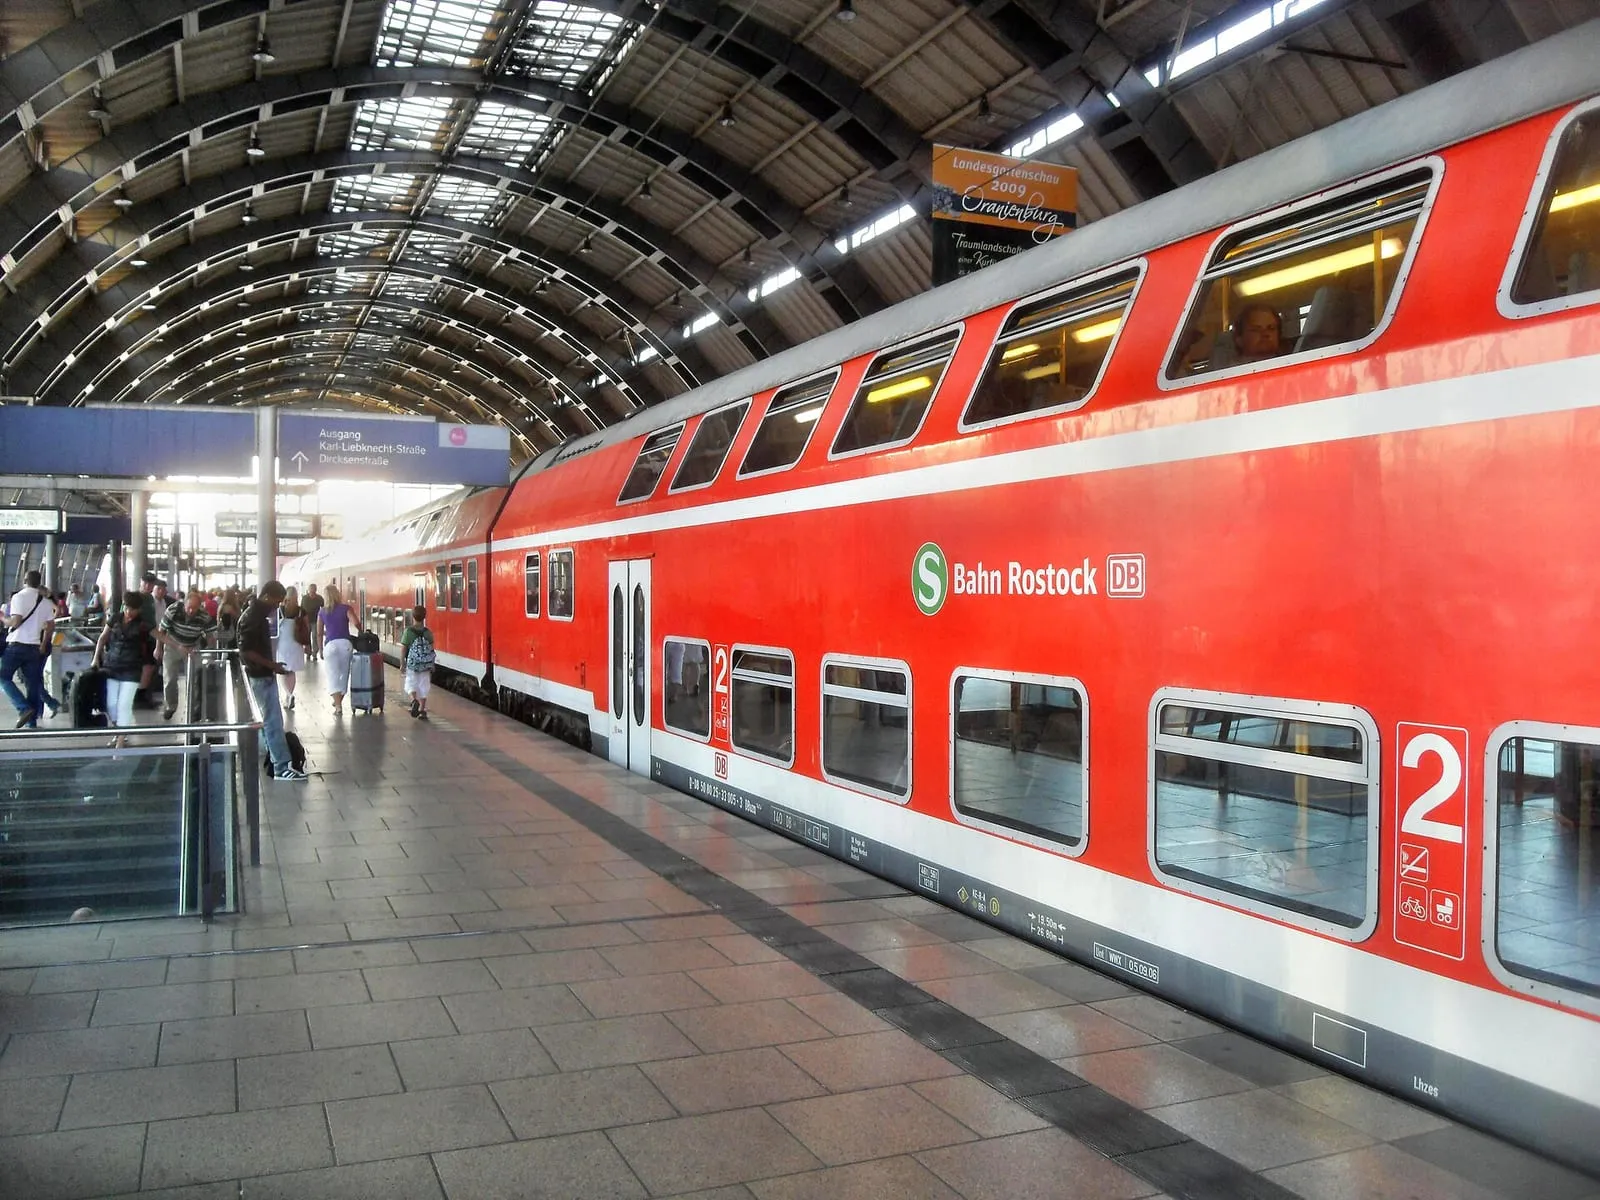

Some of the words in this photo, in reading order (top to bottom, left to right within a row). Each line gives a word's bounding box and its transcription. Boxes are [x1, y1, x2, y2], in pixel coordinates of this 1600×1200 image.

[952, 157, 1060, 185] Landesgartenschau
[991, 180, 1027, 198] 2009
[961, 185, 1064, 245] Oranienburg
[319, 428, 361, 441] Ausgang
[319, 441, 426, 455] Karl-Liebknecht-Straße
[319, 453, 389, 466] Dircksenstraße
[917, 549, 943, 609] S
[953, 561, 1001, 595] Bahn
[1008, 557, 1098, 595] Rostock
[1110, 558, 1143, 593] DB
[715, 648, 728, 693] 2
[716, 754, 727, 777] DB
[1401, 733, 1463, 844] 2
[1128, 959, 1157, 980] 05.09.06
[1413, 1075, 1439, 1097] Lhzes
